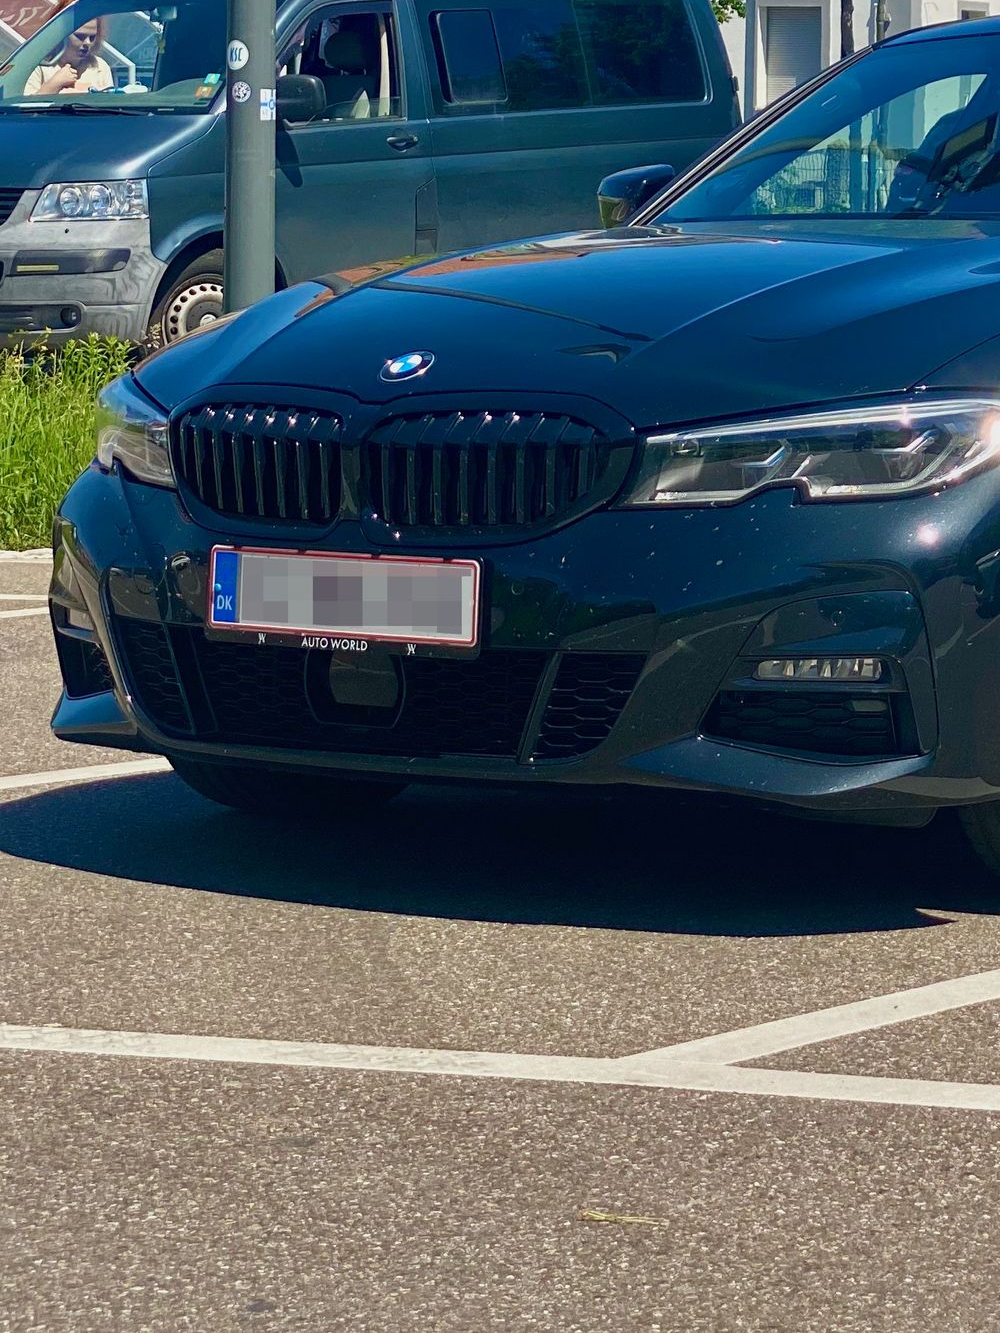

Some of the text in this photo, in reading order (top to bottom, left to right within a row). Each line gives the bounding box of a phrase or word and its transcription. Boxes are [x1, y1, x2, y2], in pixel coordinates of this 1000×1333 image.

[216, 594, 233, 611] DK
[301, 636, 368, 652] AUTO WORLD
